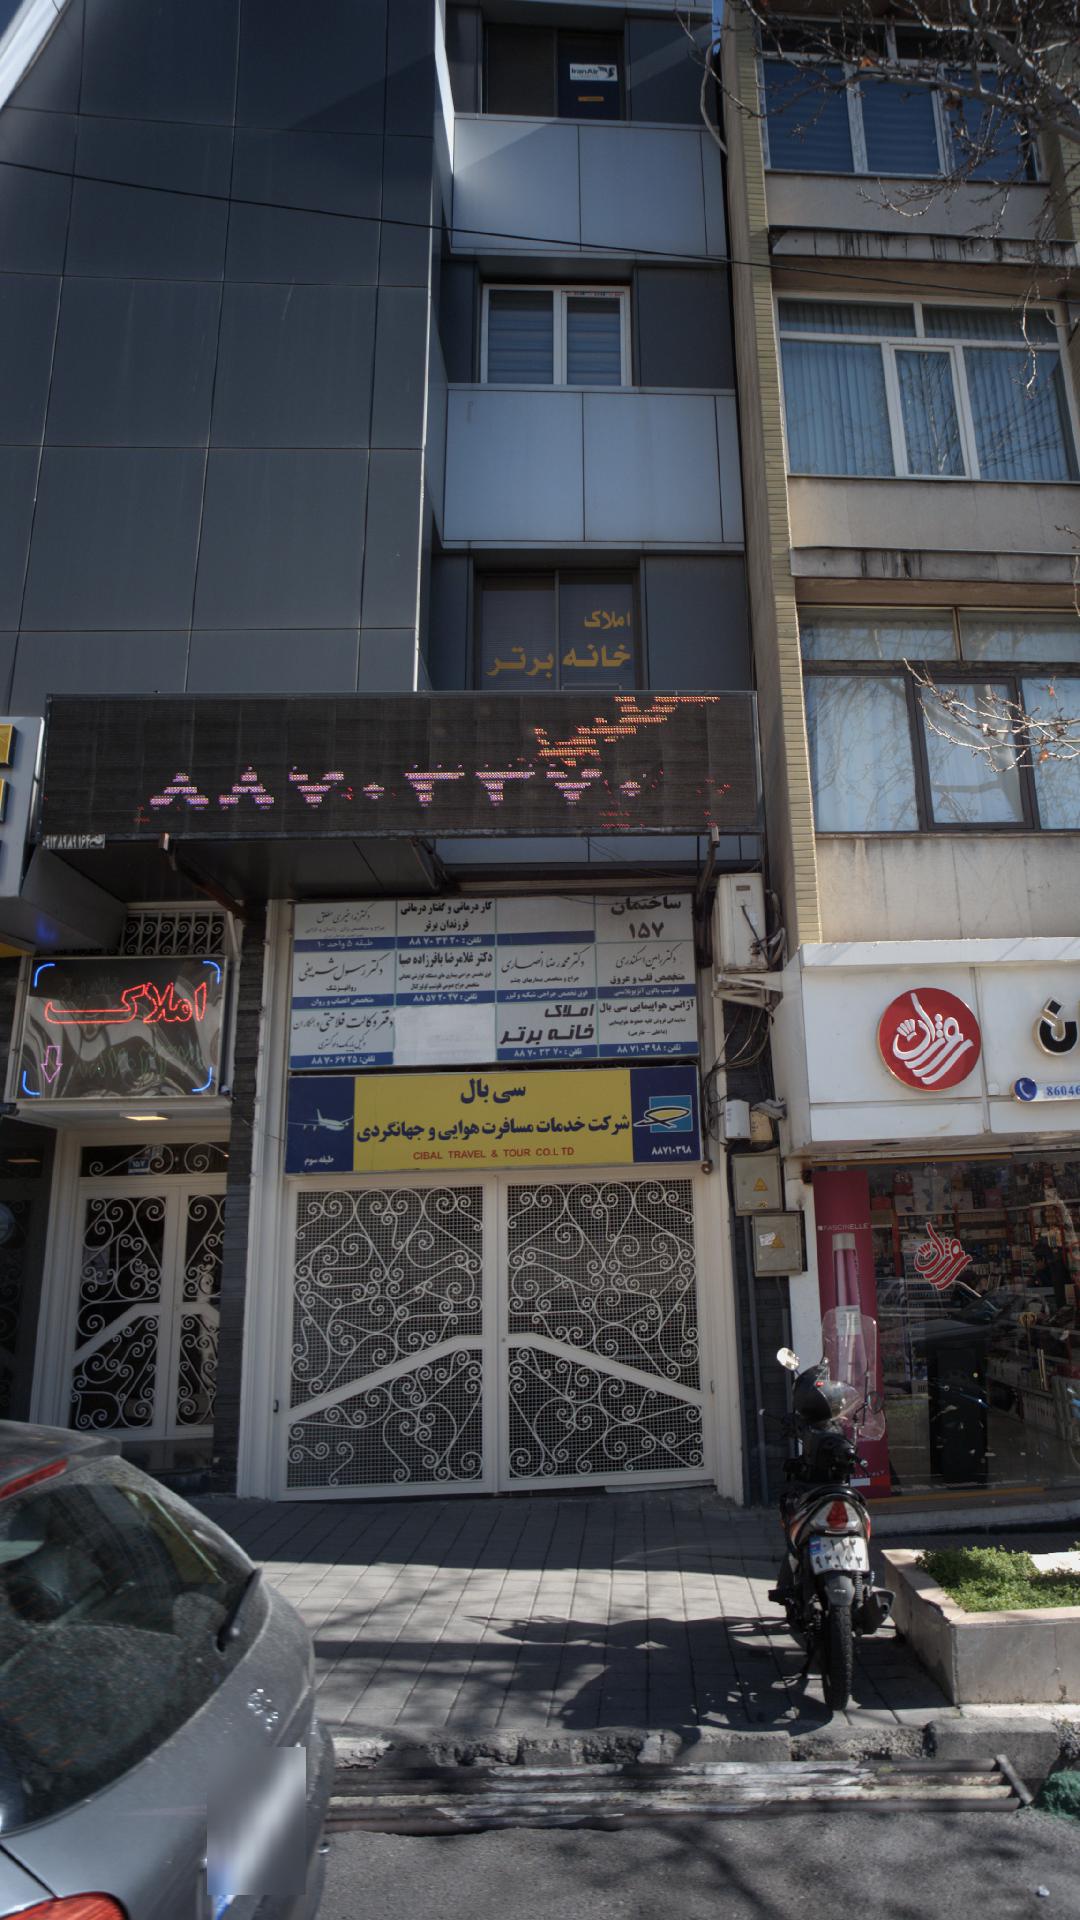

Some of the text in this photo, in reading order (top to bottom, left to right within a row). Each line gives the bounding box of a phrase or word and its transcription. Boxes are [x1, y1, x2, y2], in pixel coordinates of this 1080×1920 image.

[583, 609, 632, 630] املاک
[486, 643, 632, 679] خانه برتر
[400, 902, 427, 916] درمانی
[428, 902, 446, 914] گفتار
[454, 901, 479, 914] درمانی
[611, 896, 681, 915] ساختمان
[629, 920, 665, 939] ۱۵۷
[476, 951, 493, 966] دکتر
[44, 982, 208, 1024] املاک
[544, 1003, 595, 1018] املاک
[669, 998, 694, 1011] آژانس
[499, 1023, 595, 1045] خانه برتر
[460, 1077, 527, 1104] سی بال
[356, 1113, 630, 1143] شرکت خدمات مسافرت هوایی و جهانگردی
[413, 1150, 443, 1160] CIBAL
[448, 1149, 486, 1159] TRAVEL
[490, 1149, 498, 1158] &
[503, 1148, 531, 1157] TOUR
[823, 1222, 871, 1231] FASCINELLE
